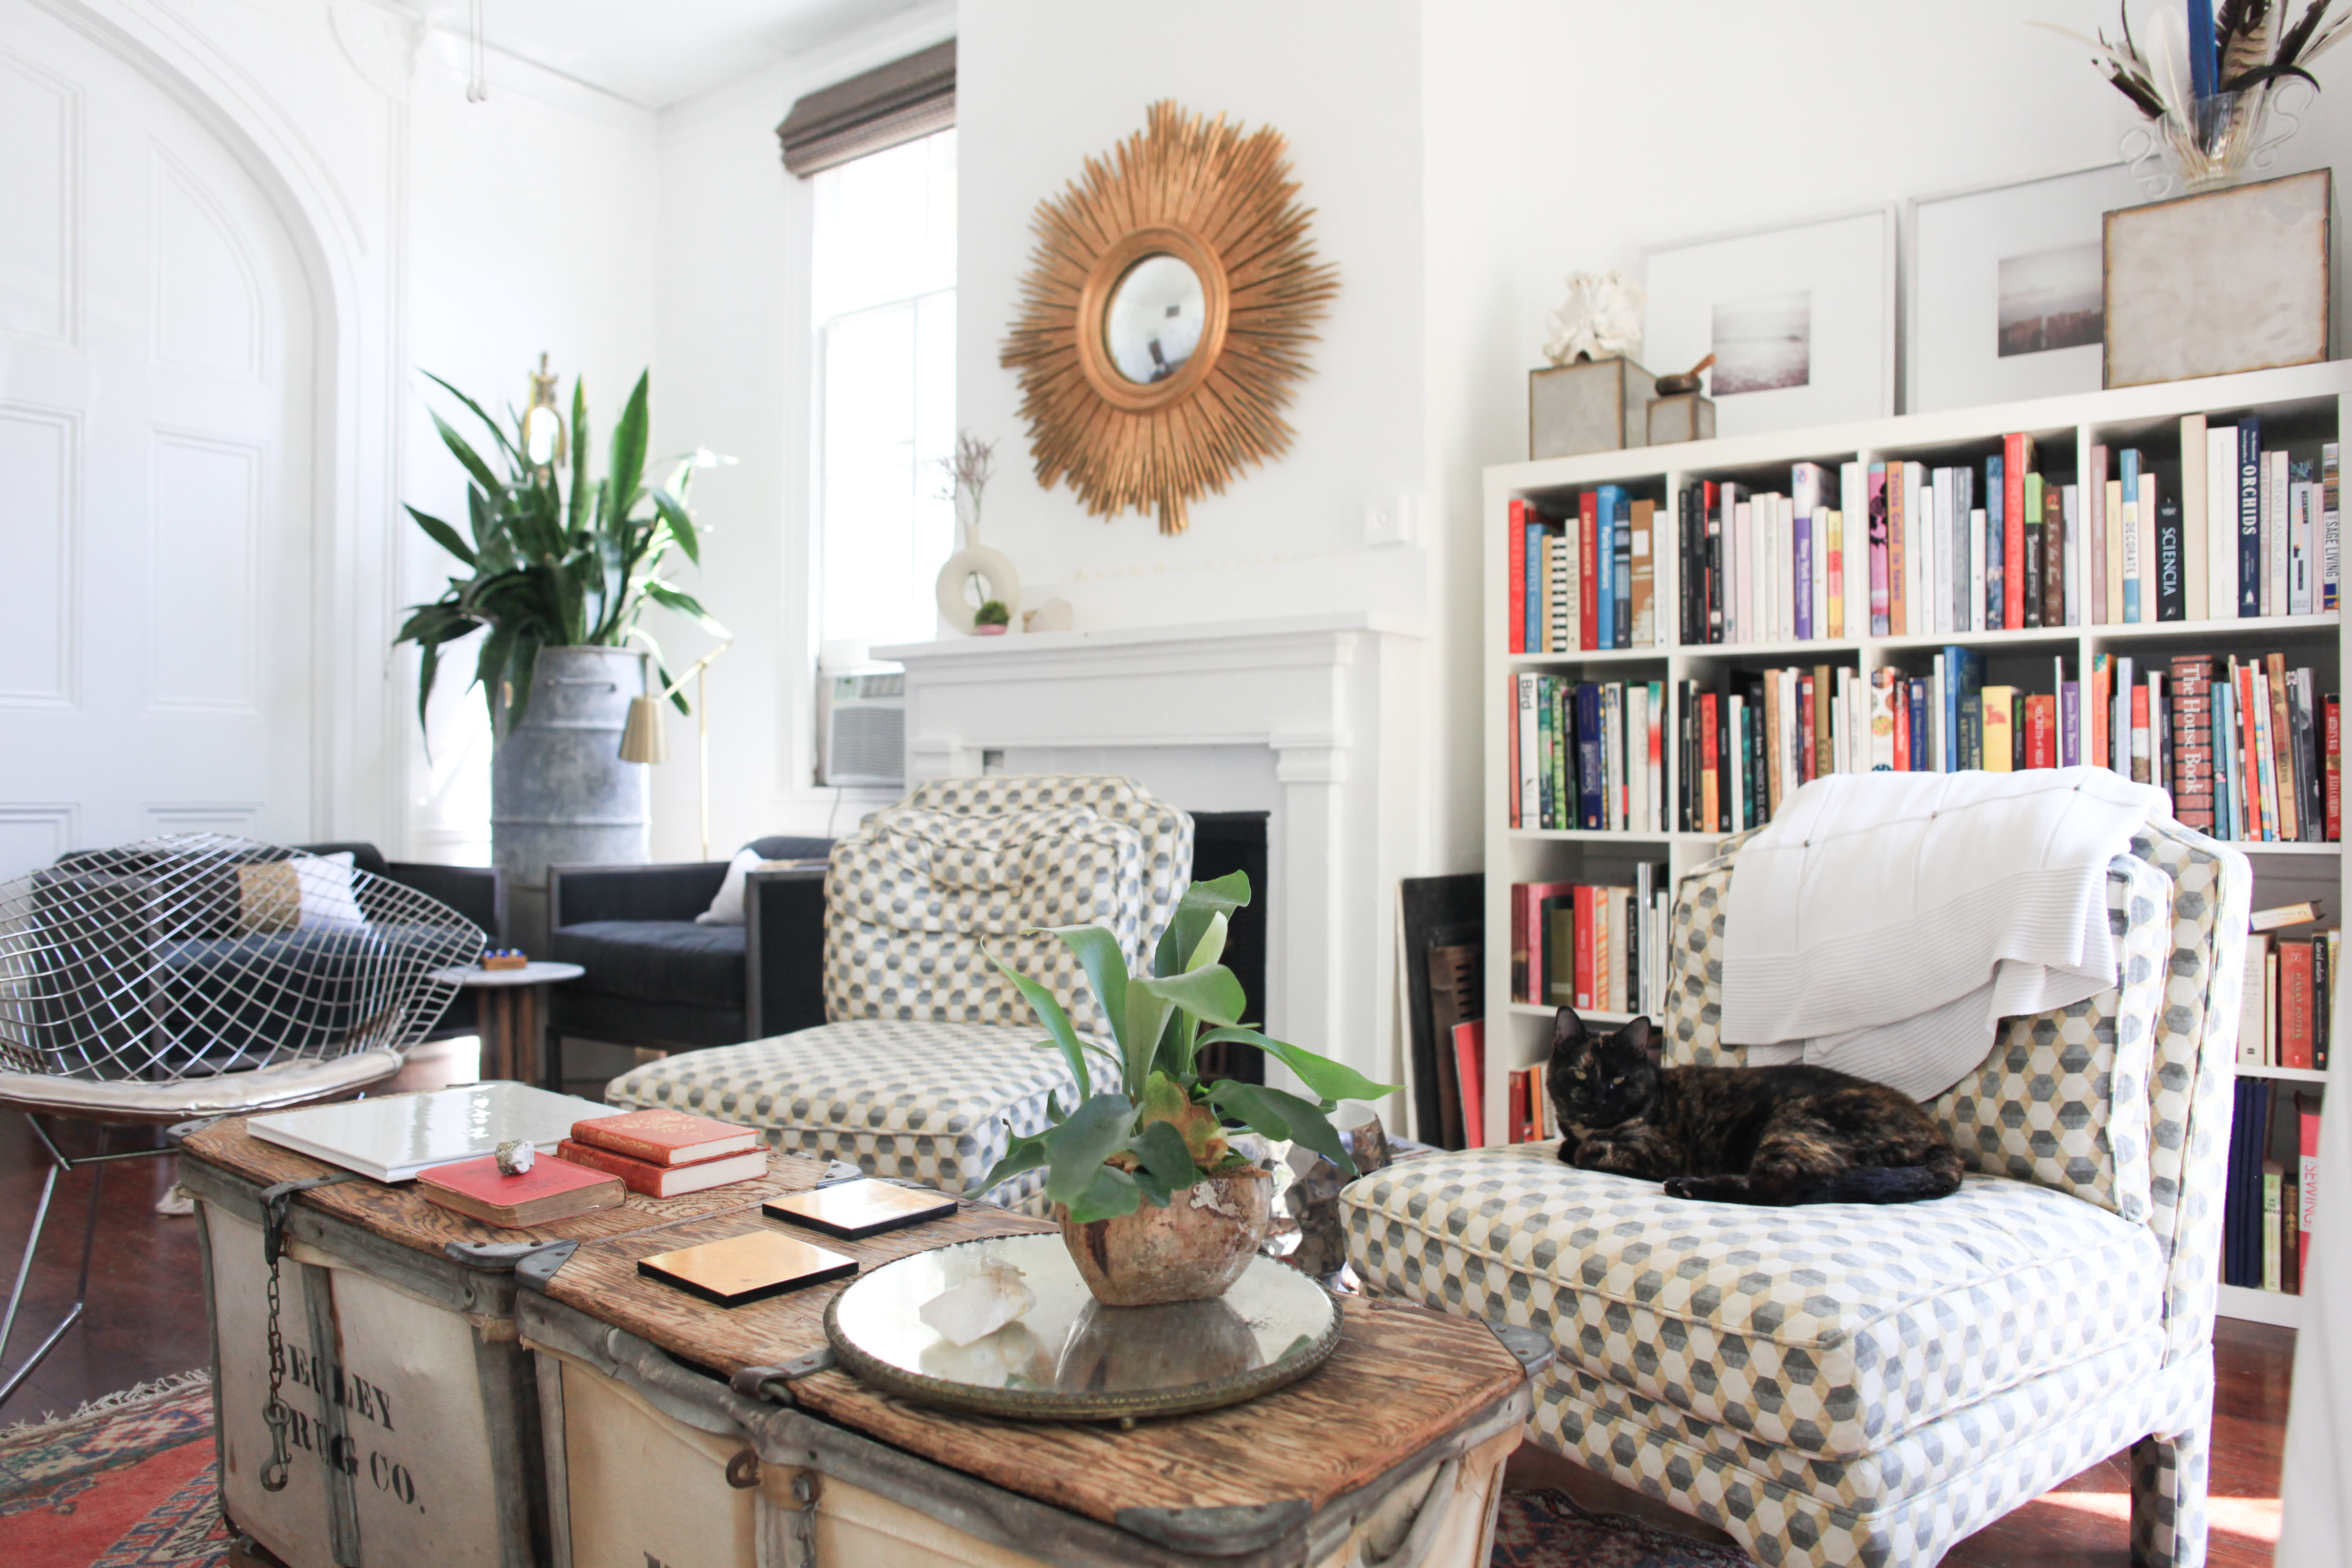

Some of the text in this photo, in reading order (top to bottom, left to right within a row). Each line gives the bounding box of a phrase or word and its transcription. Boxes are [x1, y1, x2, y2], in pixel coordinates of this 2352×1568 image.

[1891, 471, 1900, 507] Tricia
[2242, 465, 2256, 535] ORCHIDS
[1892, 512, 1901, 545] Guild
[2274, 479, 2285, 577] PRIVATE LANDSCAPES
[2326, 521, 2338, 577] SAGE LIVING
[1602, 526, 1611, 590] Paris Interiors
[1800, 538, 1809, 619] New York Interiors
[1893, 553, 1901, 567] in
[2162, 527, 2177, 596] SCIENCIA
[1567, 560, 1577, 618] HABITAT
[1521, 679, 1533, 710] Bird
[1961, 717, 1969, 770] ARCHITECT
[2182, 664, 2203, 794] The House Book
[1972, 747, 1980, 770] WEST
[2316, 942, 2325, 961] david
[2304, 1165, 2318, 1224] SEWING
[290, 1408, 426, 1514] RUG CO.
